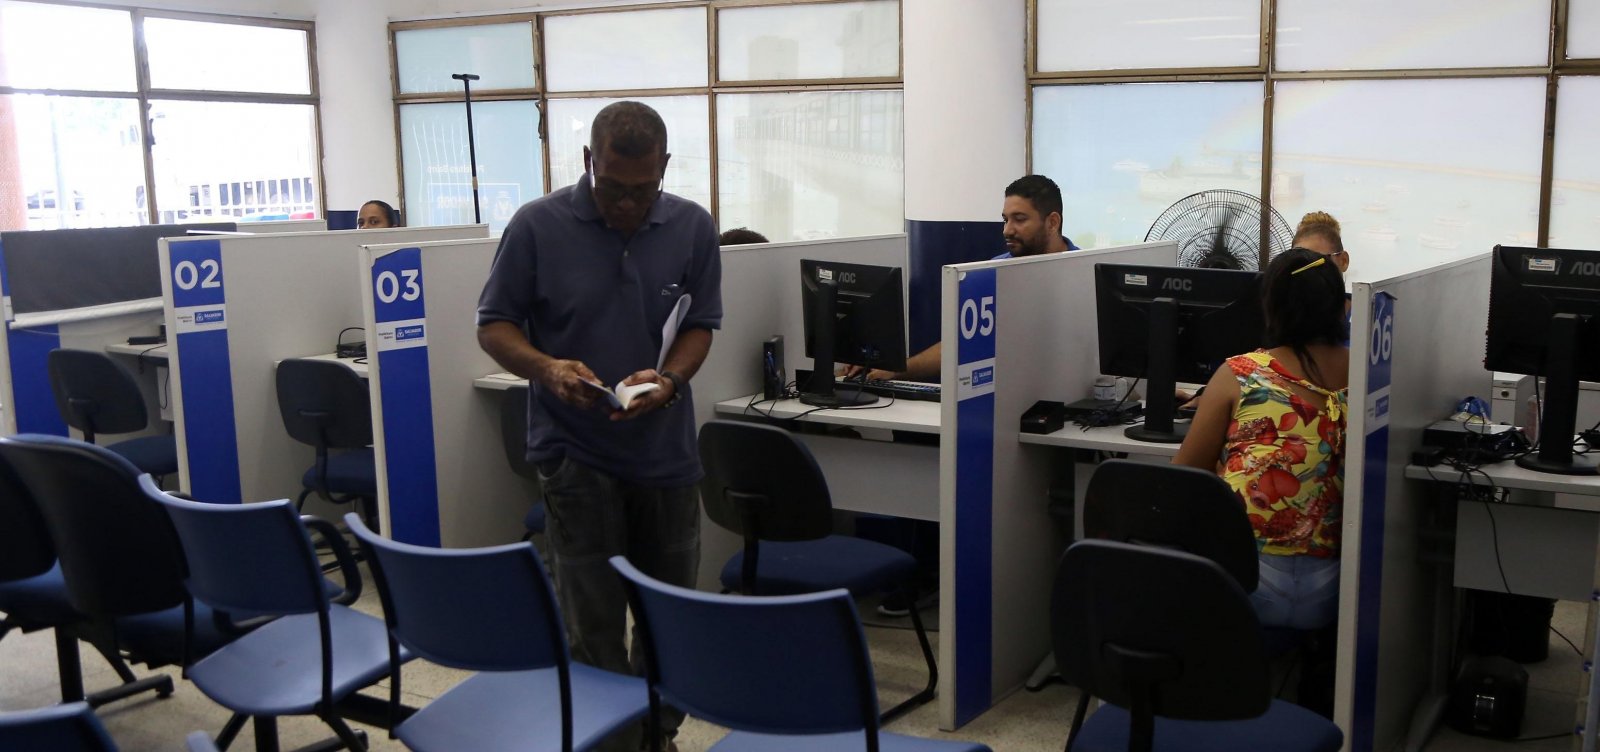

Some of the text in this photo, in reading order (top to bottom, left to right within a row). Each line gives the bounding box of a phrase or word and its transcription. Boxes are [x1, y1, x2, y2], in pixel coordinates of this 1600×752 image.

[175, 259, 220, 290] 02
[376, 269, 420, 303] 03
[838, 271, 856, 283] AOC
[1162, 277, 1192, 291] AOC
[960, 296, 994, 340] 05
[1370, 315, 1392, 365] 06
